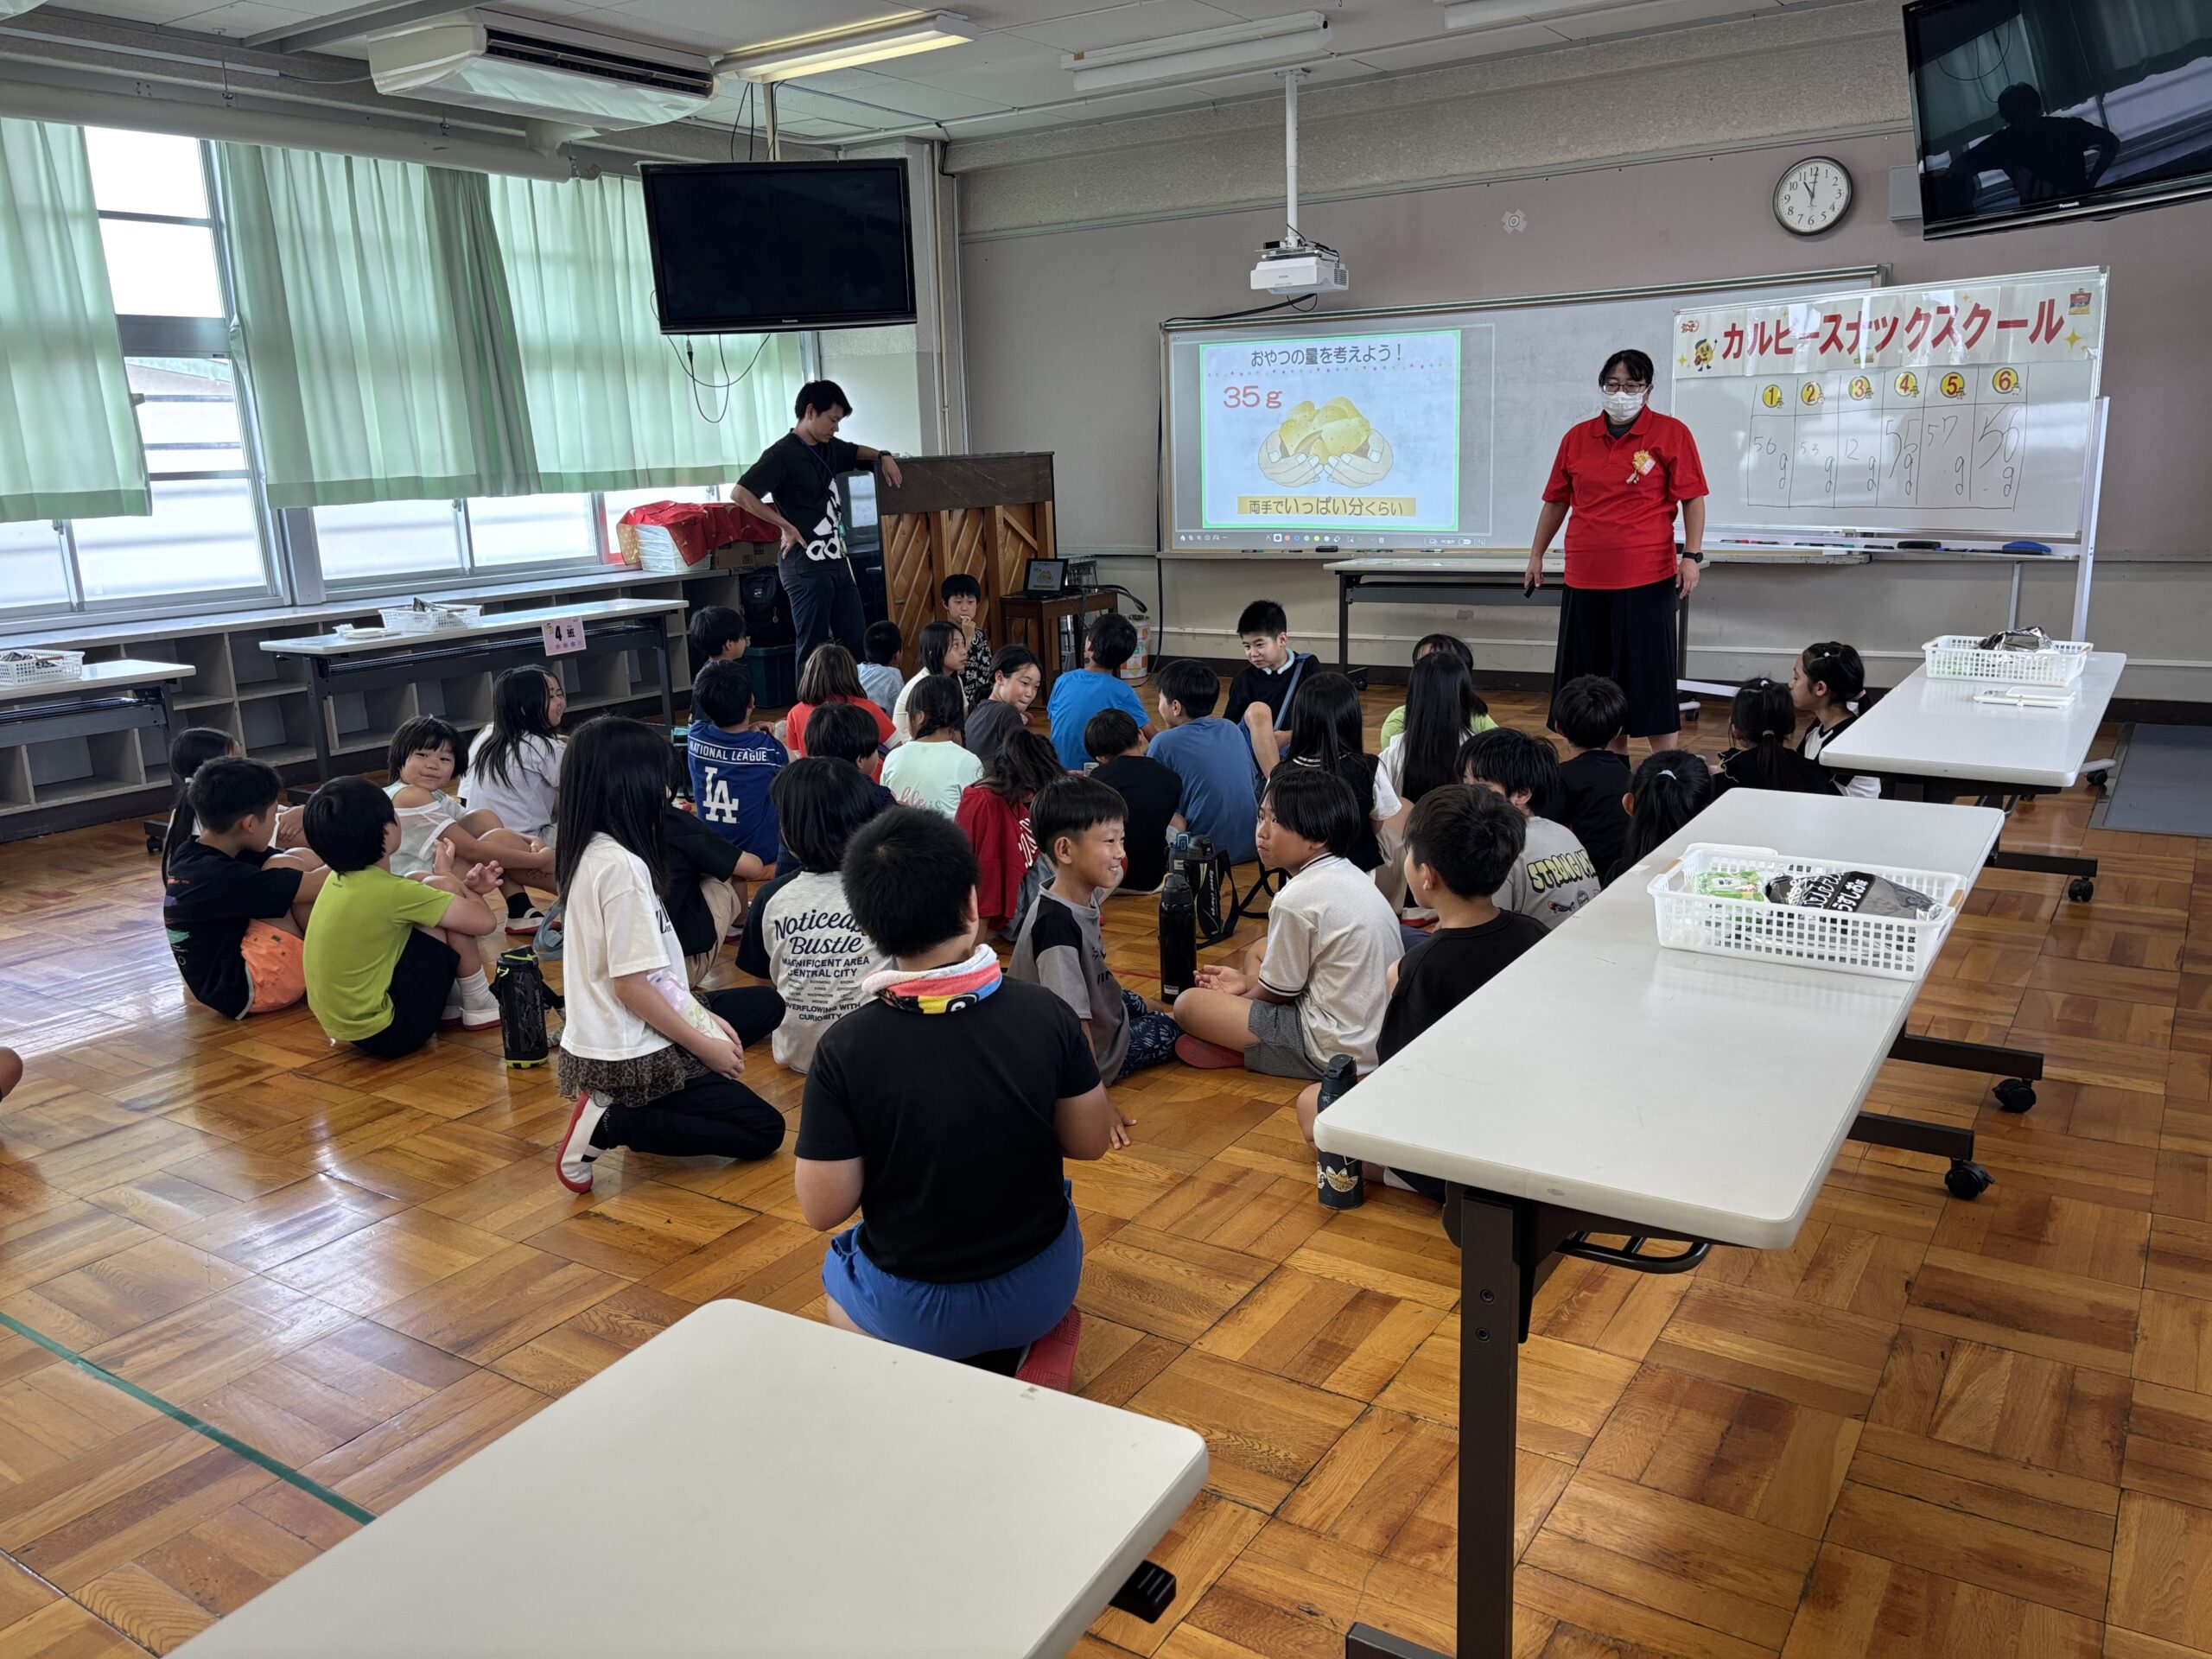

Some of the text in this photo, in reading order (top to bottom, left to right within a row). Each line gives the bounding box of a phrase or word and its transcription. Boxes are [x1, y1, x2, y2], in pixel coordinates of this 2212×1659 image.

[1799, 172, 1806, 181] 11
[1825, 169, 1828, 178] 1
[1832, 176, 1838, 186] 2
[1789, 181, 1798, 190] 10
[1835, 189, 1842, 199] 3
[1784, 194, 1790, 204] 9
[1829, 202, 1835, 212] 4
[1788, 207, 1794, 215] 8
[1798, 214, 1803, 224] 7
[1808, 215, 1815, 225] 6
[1821, 212, 1827, 221] 5
[1722, 297, 2065, 359] カルビースナックスクール
[1251, 344, 1402, 367] おやつの量を考えよう！
[1854, 378, 1864, 398] 3
[1899, 374, 1910, 393] 4
[1946, 376, 1958, 395] 5
[1999, 371, 2012, 391] 6
[1769, 387, 1774, 405] 1
[1806, 385, 1815, 403] 2
[1753, 436, 1777, 454] 56
[1779, 453, 1788, 490] g
[1824, 456, 1835, 493] g
[1866, 455, 1877, 492] g
[1904, 454, 1913, 496] g
[1955, 456, 1964, 495] g
[2002, 467, 2014, 497] g
[1249, 496, 1403, 516] 両手でいっぱい分くらい
[690, 741, 767, 761] NATIONAL LEAGUE
[702, 766, 740, 824] LA
[1527, 853, 1583, 894] STRONG
[774, 909, 868, 941] Noticea
[789, 936, 864, 955] Bustle
[782, 956, 870, 968] MAGNIFICENT AREA
[788, 968, 858, 978] CENTRAL CITY
[785, 1001, 861, 1014] OVERFLOWING WITH
[798, 1013, 842, 1021] CURIOSITY
